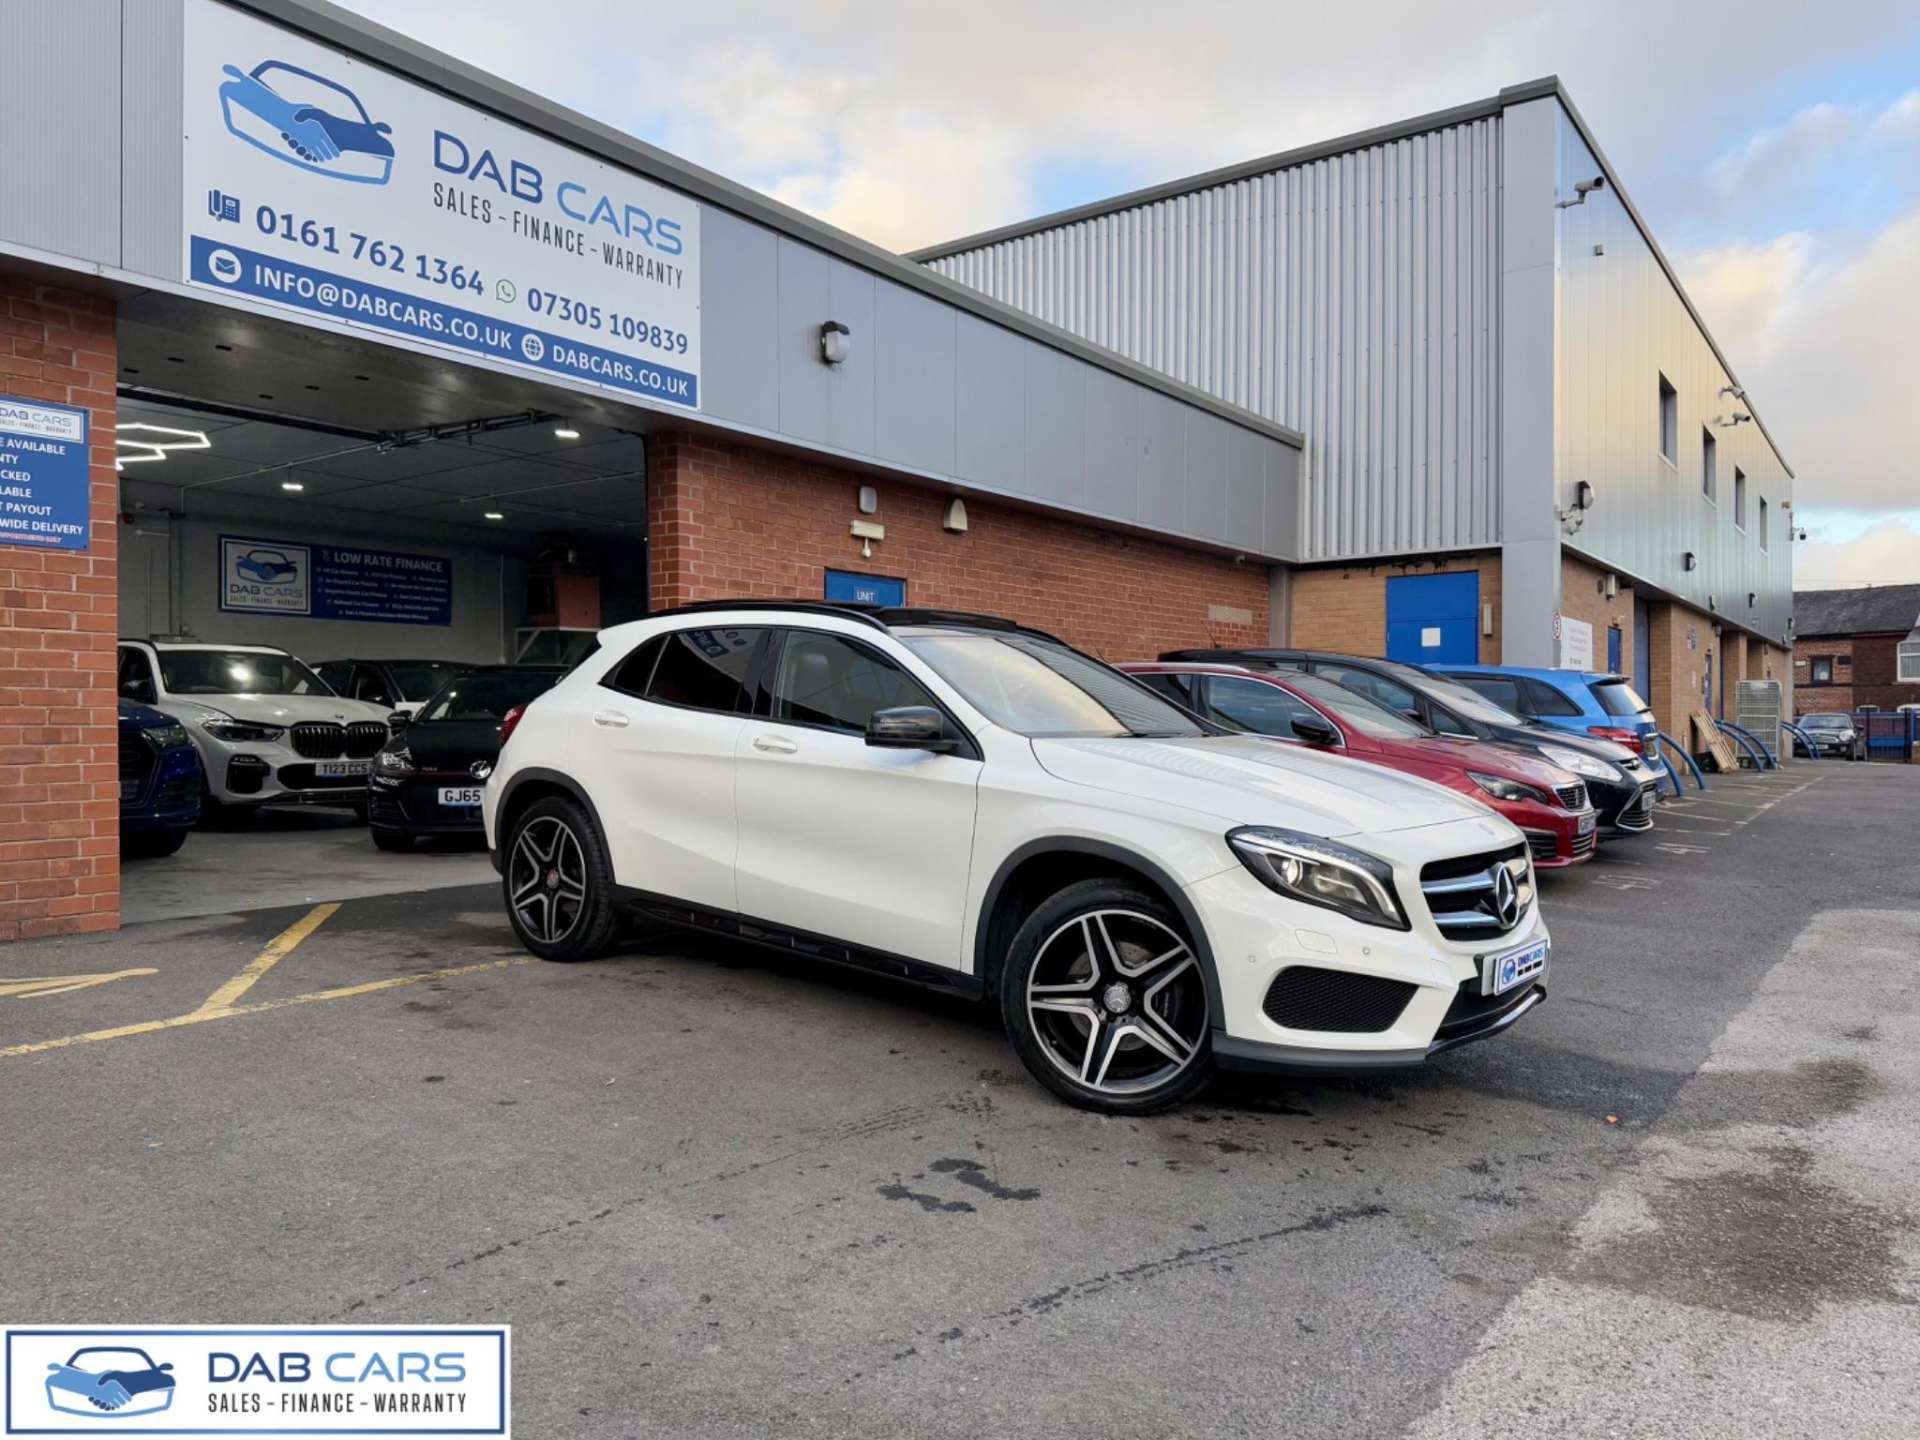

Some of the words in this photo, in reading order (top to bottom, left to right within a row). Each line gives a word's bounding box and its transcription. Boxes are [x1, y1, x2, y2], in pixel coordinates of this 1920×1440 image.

[434, 129, 543, 204] DAB
[557, 181, 683, 256] CARS
[433, 182, 491, 224] SALES
[513, 210, 585, 256] FINANCE
[602, 242, 683, 290] WARRANTY
[256, 205, 340, 254] 0161
[350, 232, 405, 273] 762
[416, 254, 484, 296] 1364
[255, 264, 512, 350] INFO@DABCARS.CO.UK
[528, 287, 601, 330] 07305
[609, 313, 689, 355] 109839
[552, 344, 689, 397] DABCARS.CO.UK
[32, 414, 72, 427] CARS
[6, 438, 67, 456] AVAILABLE
[6, 502, 52, 517] PAYOUT
[31, 521, 84, 535] DELIVERY
[334, 551, 362, 565] LOW
[364, 554, 393, 568] RATE
[395, 557, 443, 573] FINANCE
[230, 584, 260, 595] DAB
[445, 790, 481, 802] GJ65
